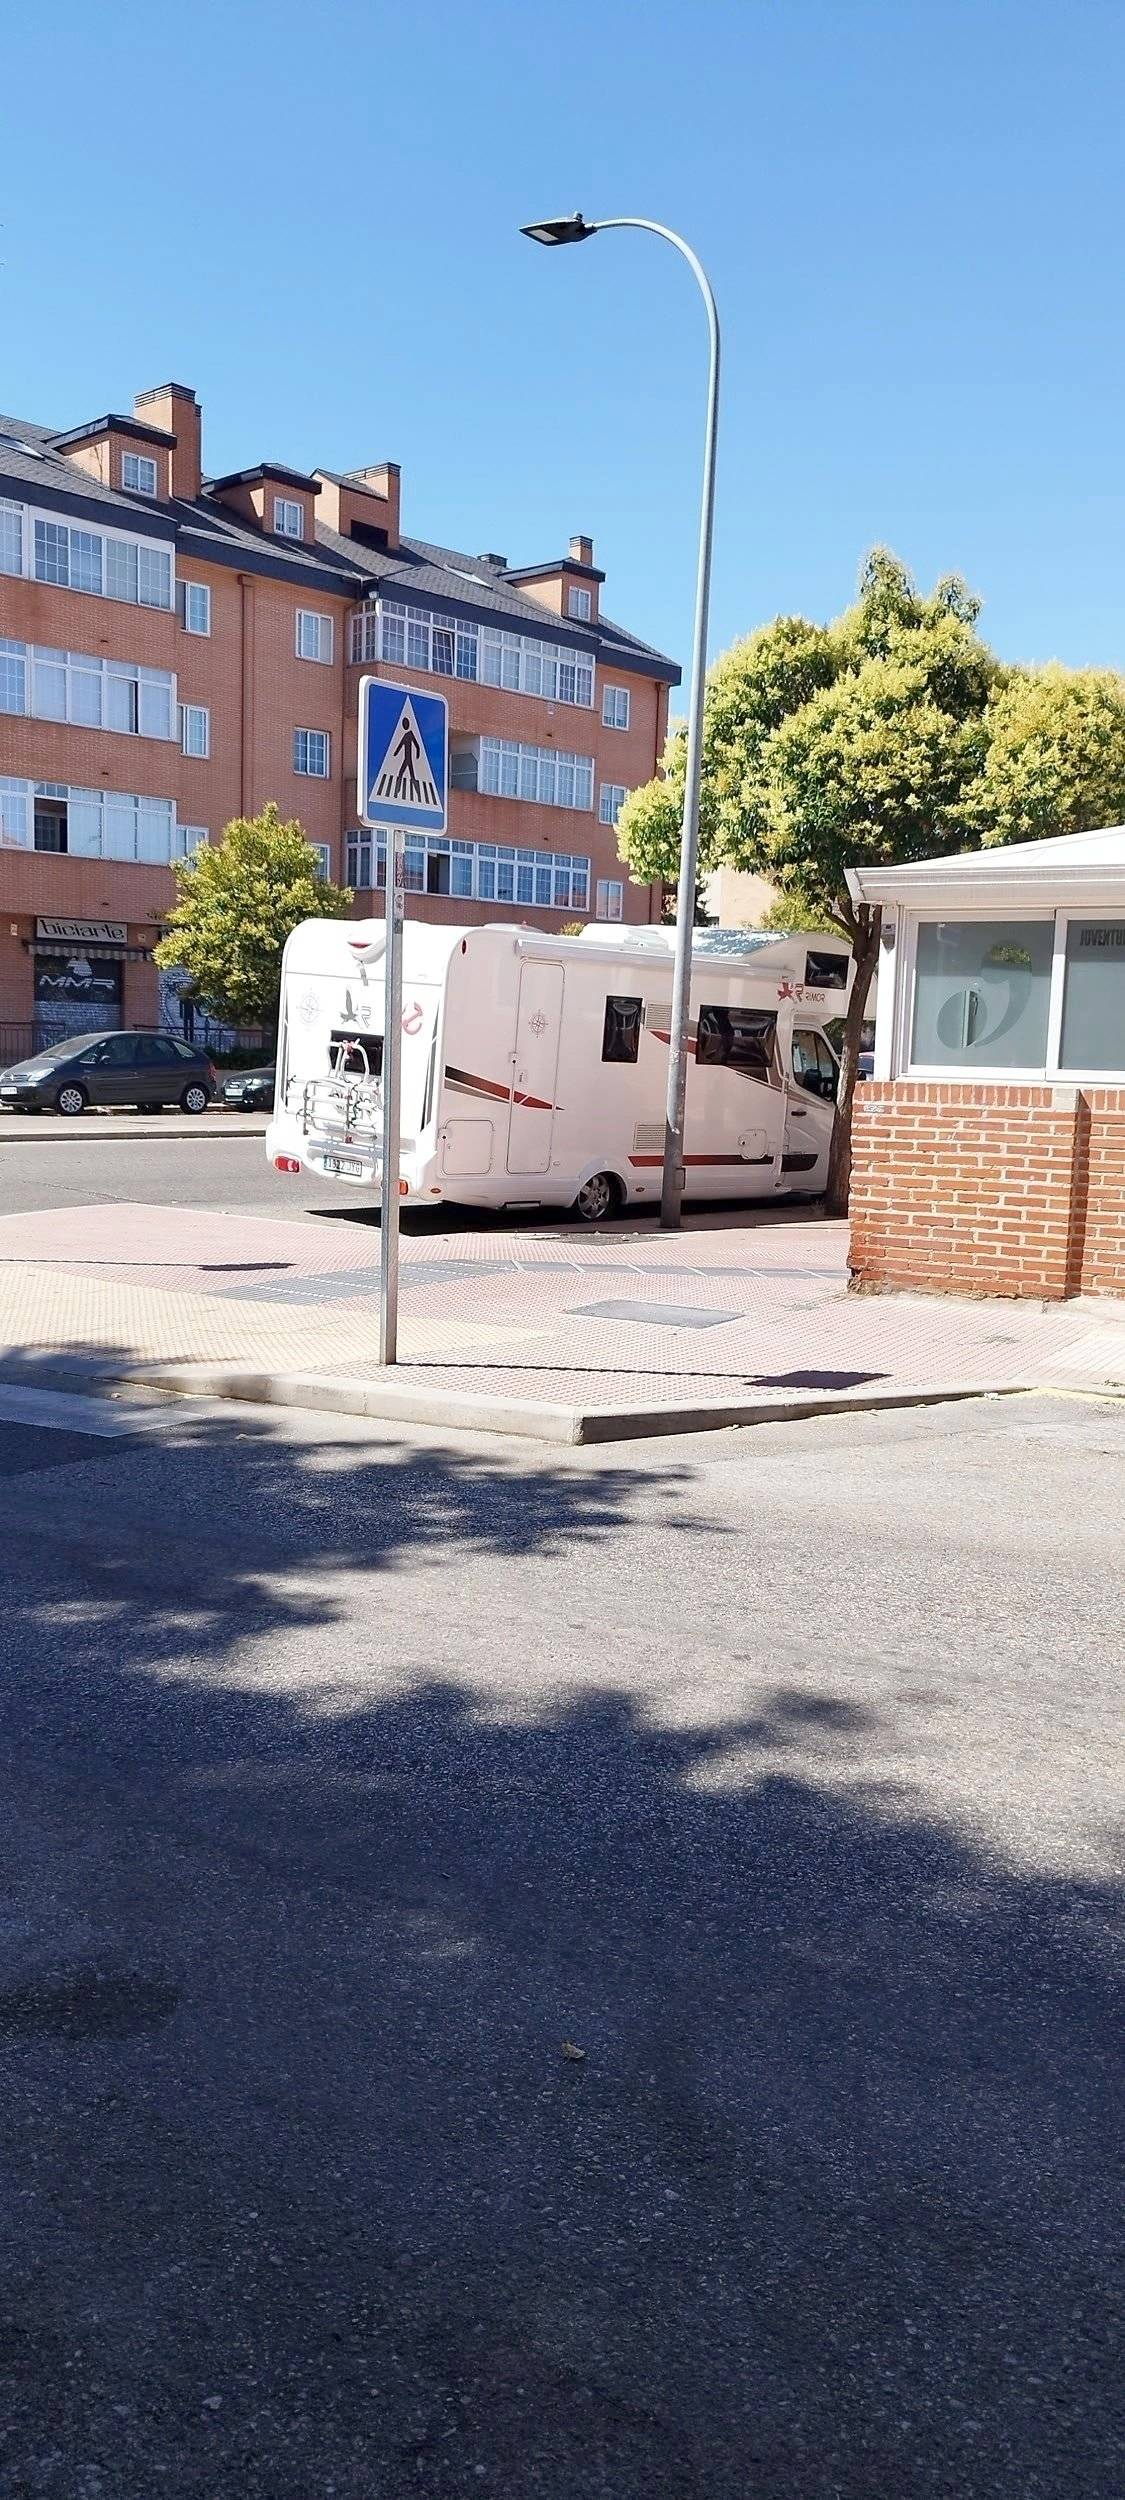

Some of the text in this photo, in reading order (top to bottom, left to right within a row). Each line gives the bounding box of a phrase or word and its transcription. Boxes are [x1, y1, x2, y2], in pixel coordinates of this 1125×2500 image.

[40, 919, 124, 939] biciarte
[1080, 928, 1125, 946] JUVENTU
[39, 975, 115, 989] MMR
